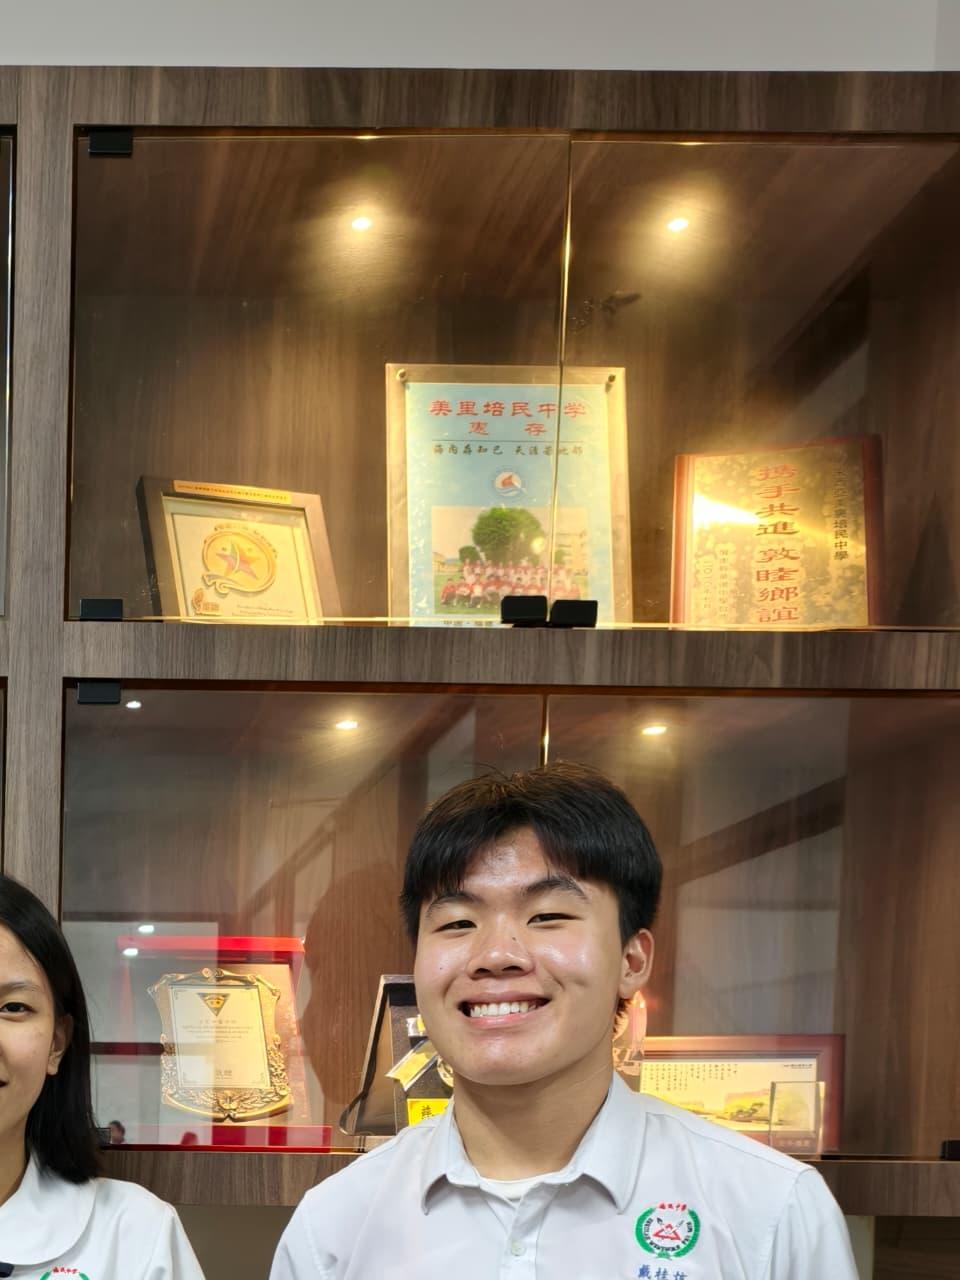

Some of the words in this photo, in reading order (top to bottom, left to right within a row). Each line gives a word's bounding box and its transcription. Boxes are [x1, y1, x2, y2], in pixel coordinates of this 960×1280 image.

[430, 400, 587, 419] 美里培民中学
